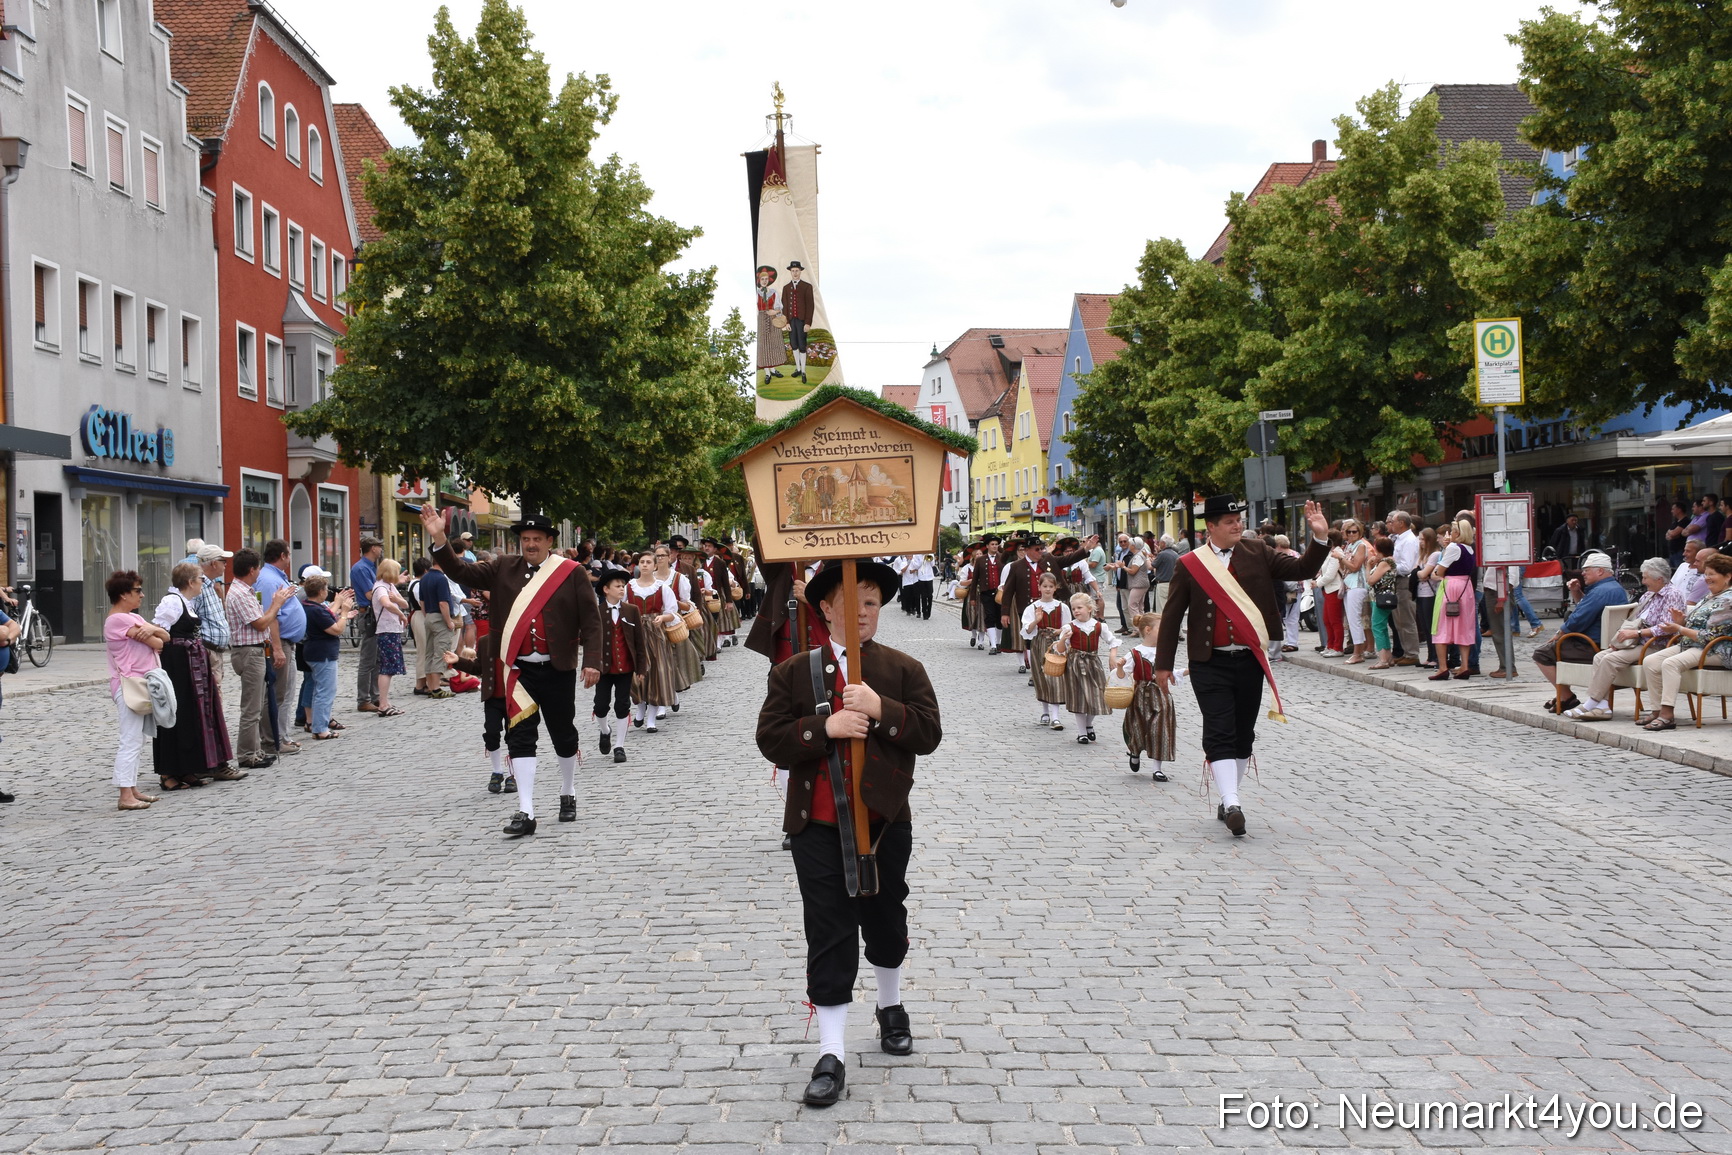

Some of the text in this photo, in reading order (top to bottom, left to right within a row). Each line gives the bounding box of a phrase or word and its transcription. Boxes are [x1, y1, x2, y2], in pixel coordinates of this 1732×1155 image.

[1489, 332, 1507, 351] H
[1484, 361, 1513, 369] Marktplatz
[82, 404, 158, 464] Eilles
[812, 425, 881, 445] Heimat u.
[772, 440, 914, 460] Volkstrachtenverein
[1070, 510, 1076, 521] P
[803, 530, 891, 550] Sindlbach
